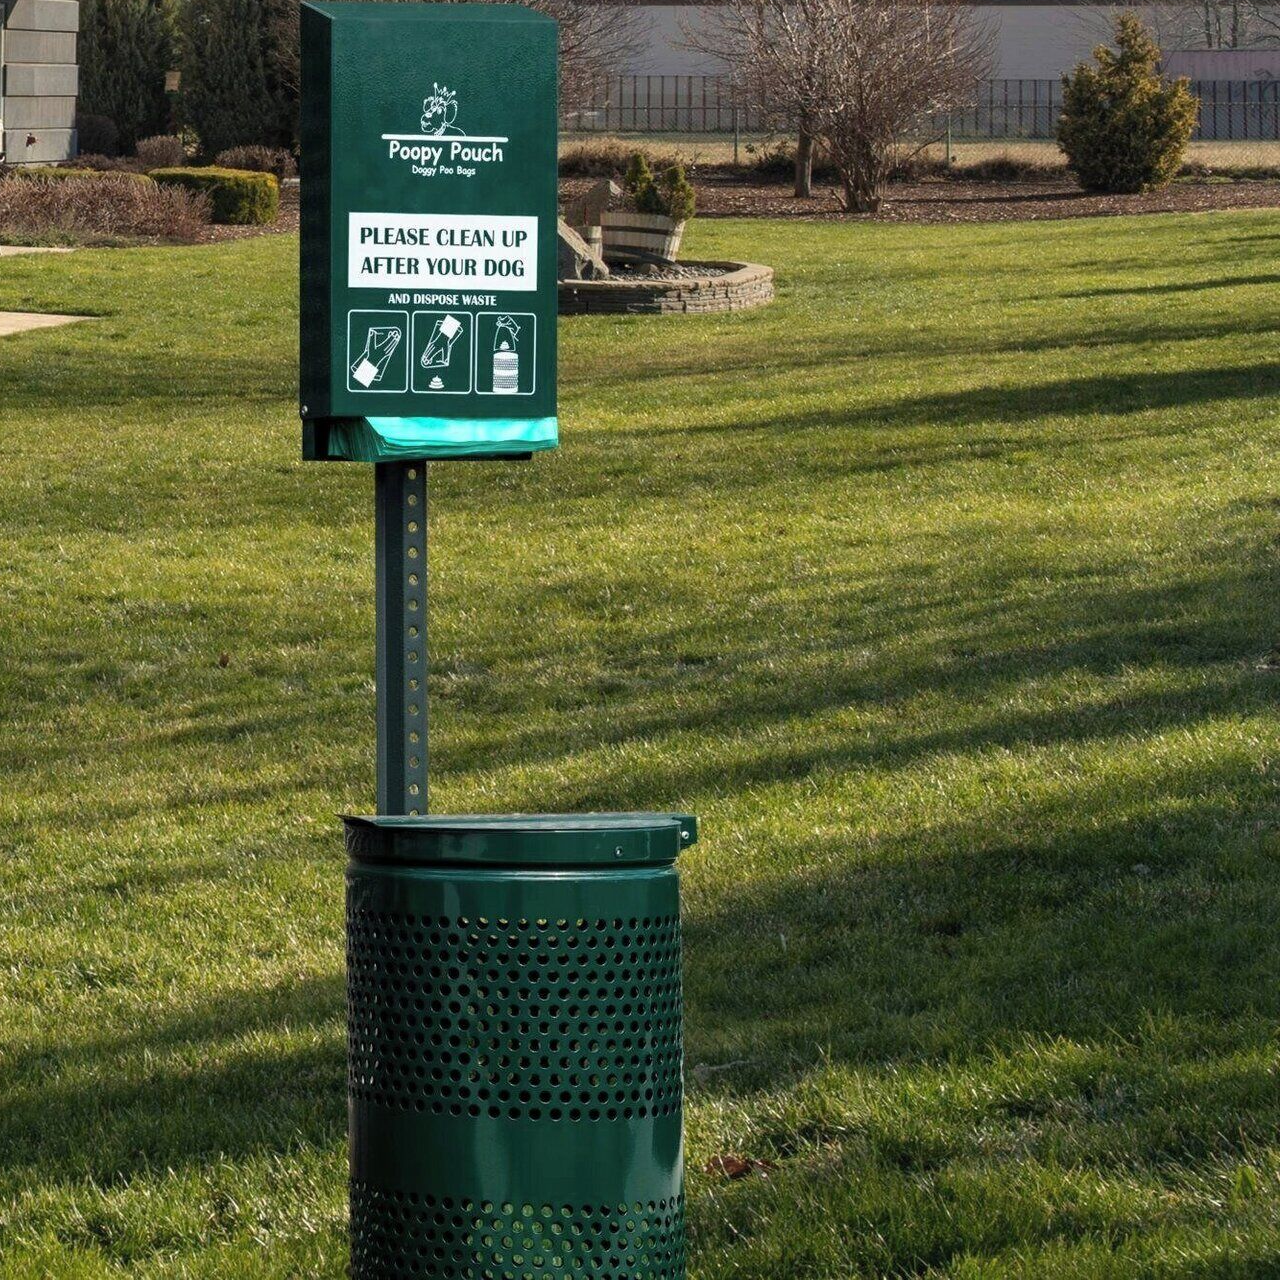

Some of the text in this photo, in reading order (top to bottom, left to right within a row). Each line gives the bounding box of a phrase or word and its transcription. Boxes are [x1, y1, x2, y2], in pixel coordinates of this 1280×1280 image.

[389, 140, 503, 166] Poopy Pouch
[412, 164, 476, 177] Doggy Poo Bags
[360, 226, 528, 248] PLEASE CLEAN UP
[360, 256, 525, 277] AFTER YOUR DOG
[388, 293, 497, 306] AND DISPOSE WASTE
